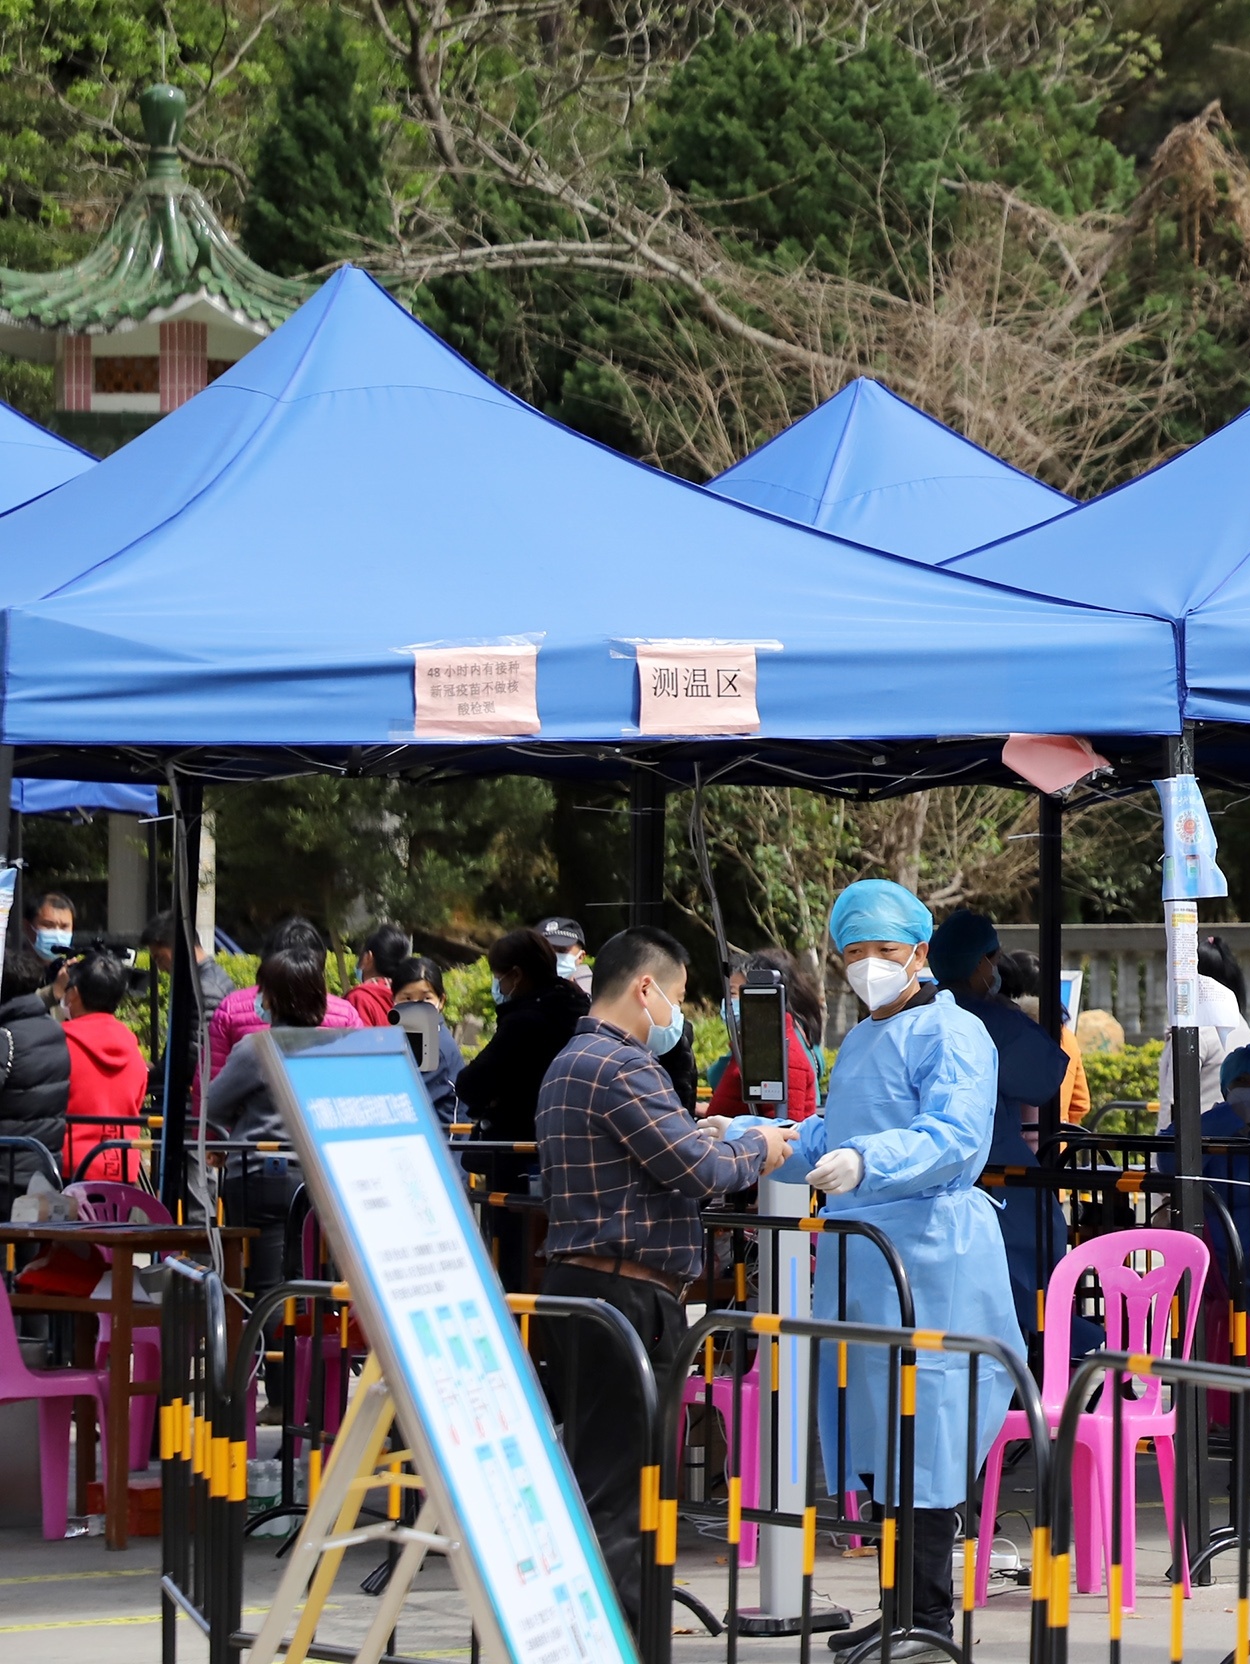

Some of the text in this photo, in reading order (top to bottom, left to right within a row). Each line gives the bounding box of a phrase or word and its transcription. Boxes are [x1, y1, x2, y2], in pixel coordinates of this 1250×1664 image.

[430, 680, 520, 698] 新冠疫苗不做核
[652, 667, 741, 698] 测温区
[457, 701, 496, 716] 酸检测
